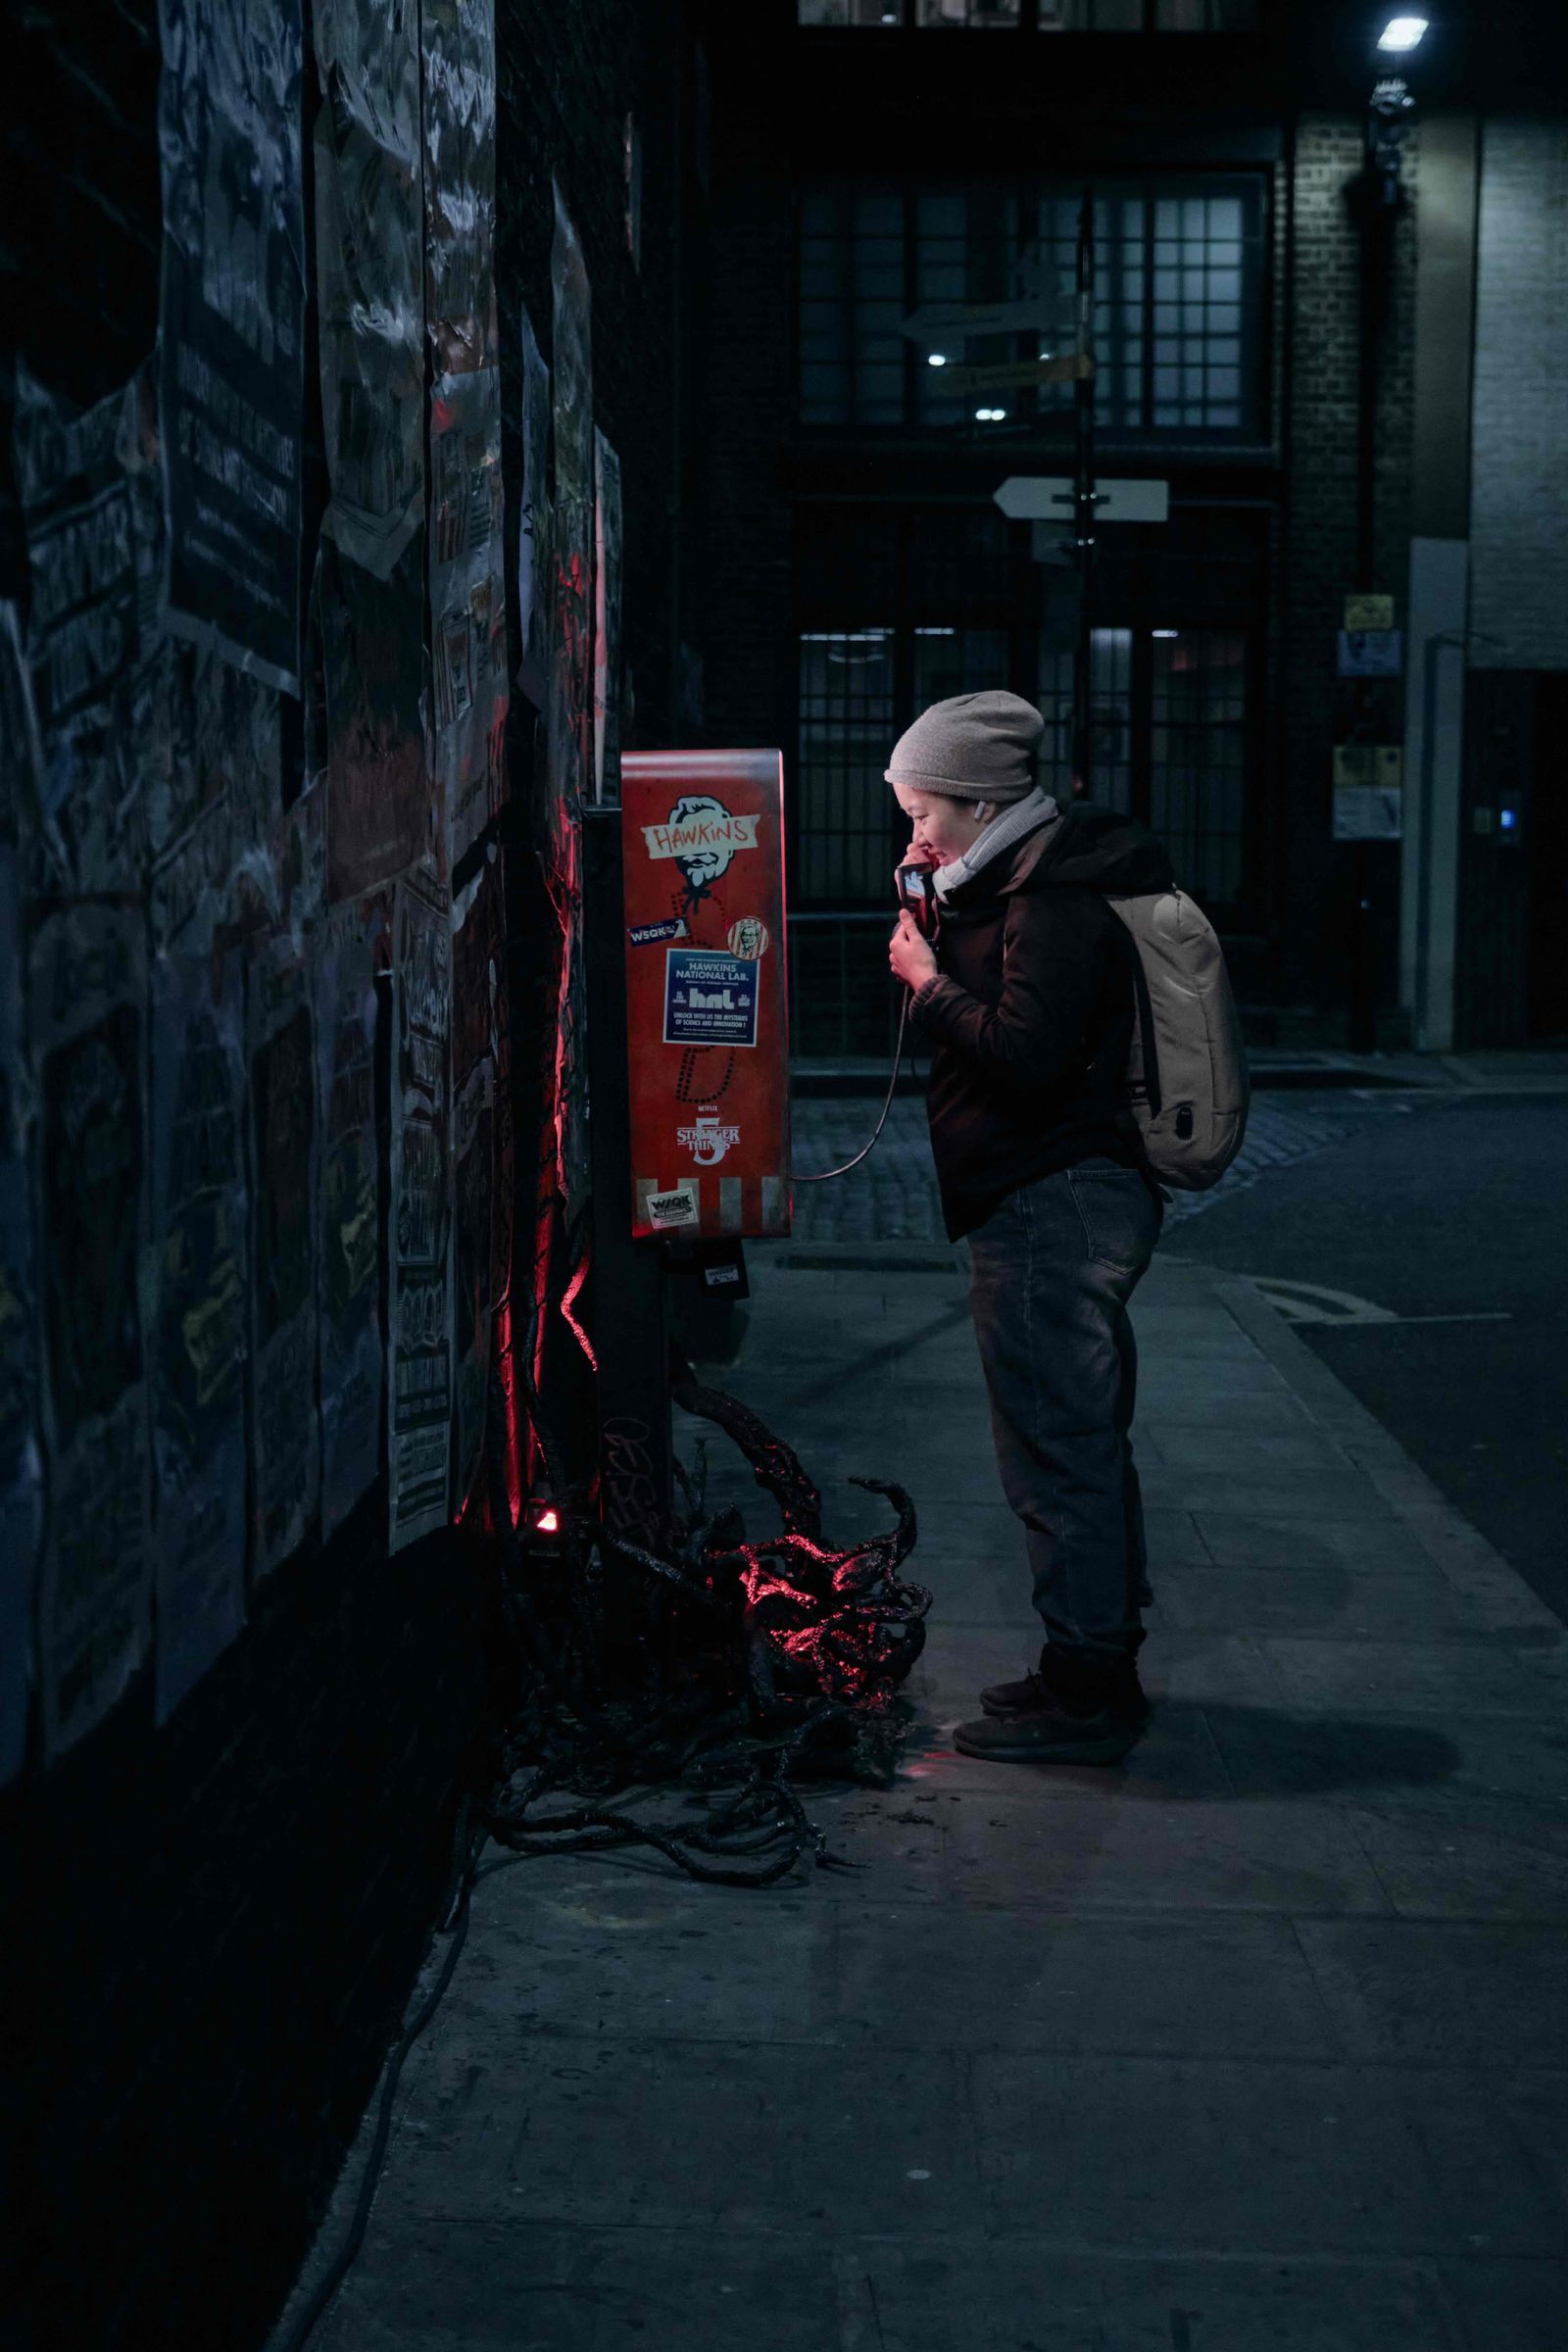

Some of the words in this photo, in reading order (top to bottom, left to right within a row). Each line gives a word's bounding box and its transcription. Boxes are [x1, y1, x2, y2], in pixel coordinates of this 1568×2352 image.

[630, 926, 666, 942] WSQK
[690, 962, 737, 972] HAWKINS
[676, 970, 726, 980] NATIONAL
[676, 1128, 741, 1144] STRANGER
[687, 1140, 731, 1151] THINS
